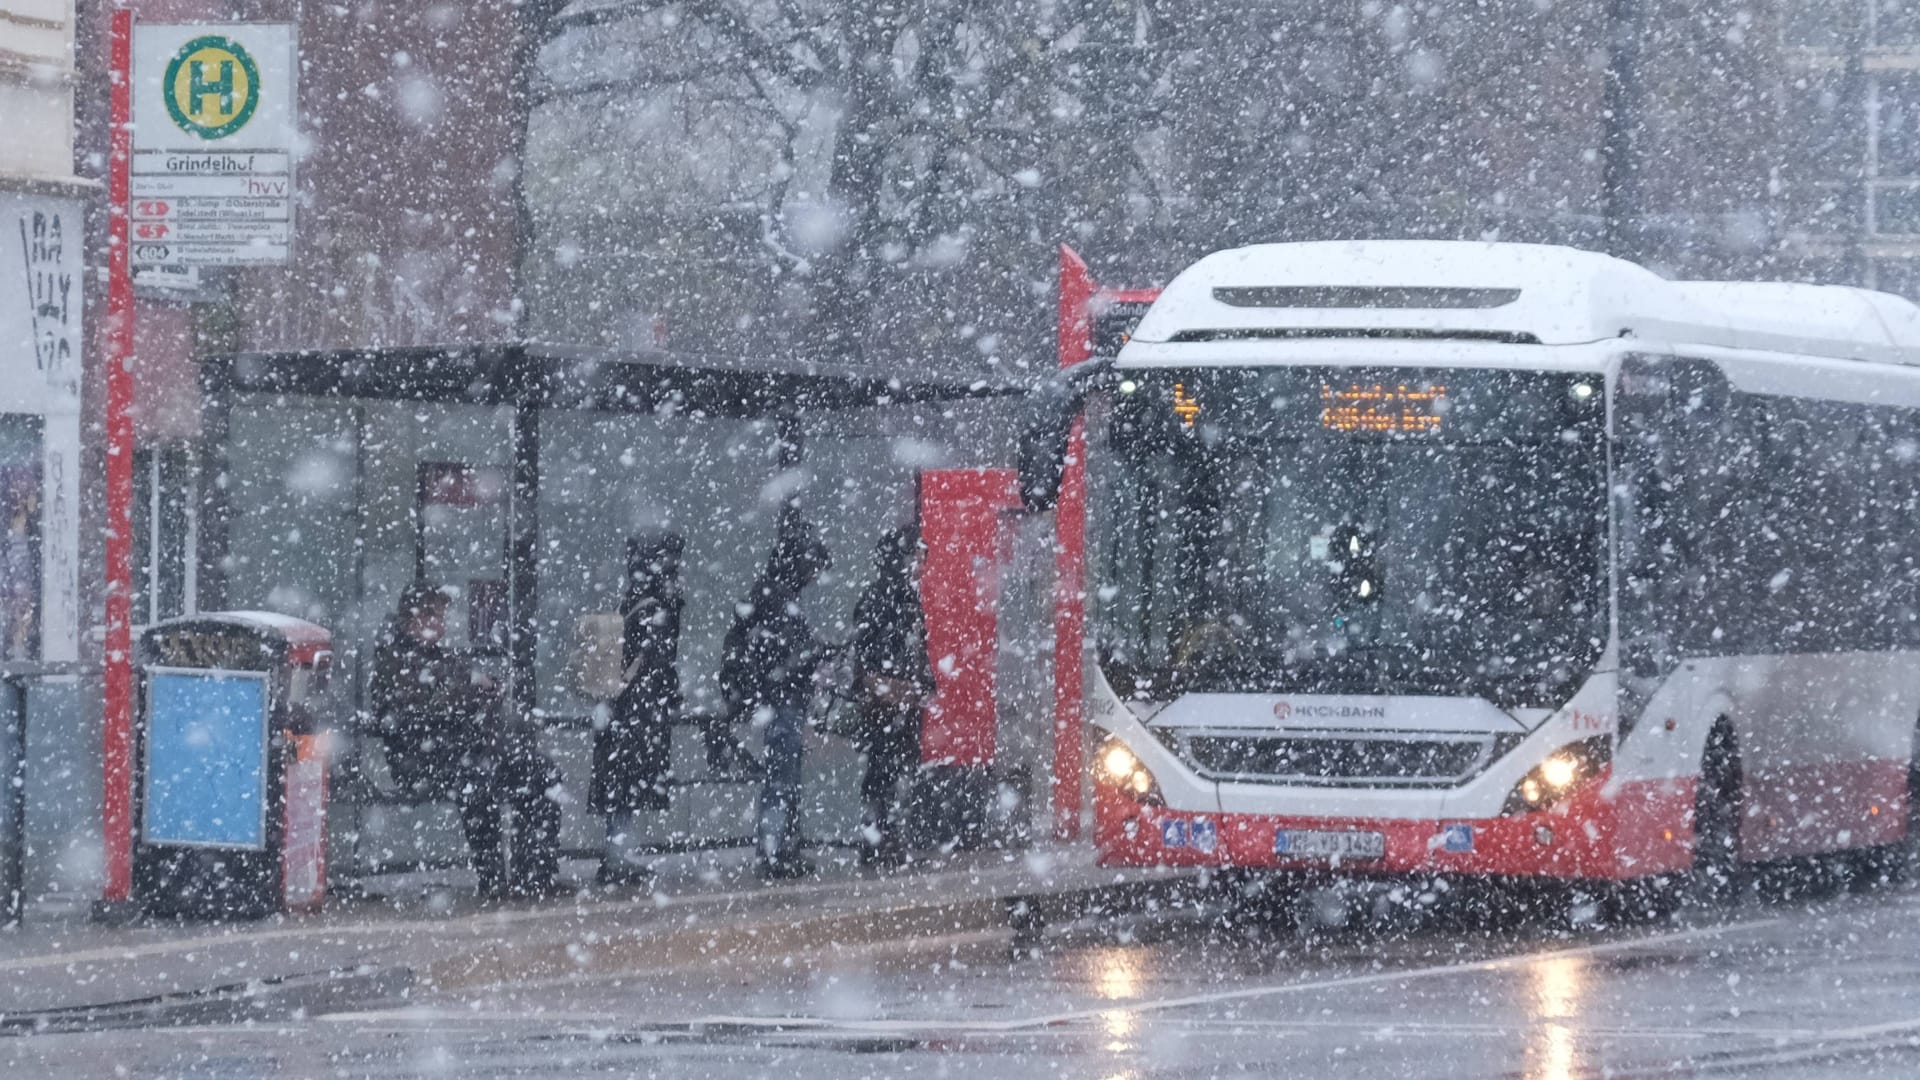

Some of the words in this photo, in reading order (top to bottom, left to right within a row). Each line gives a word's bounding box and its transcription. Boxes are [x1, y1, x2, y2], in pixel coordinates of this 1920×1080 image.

[190, 60, 233, 115] H
[248, 178, 285, 194] hvv
[1175, 383, 1199, 426] 4
[1295, 705, 1385, 718] HOCHBAHN
